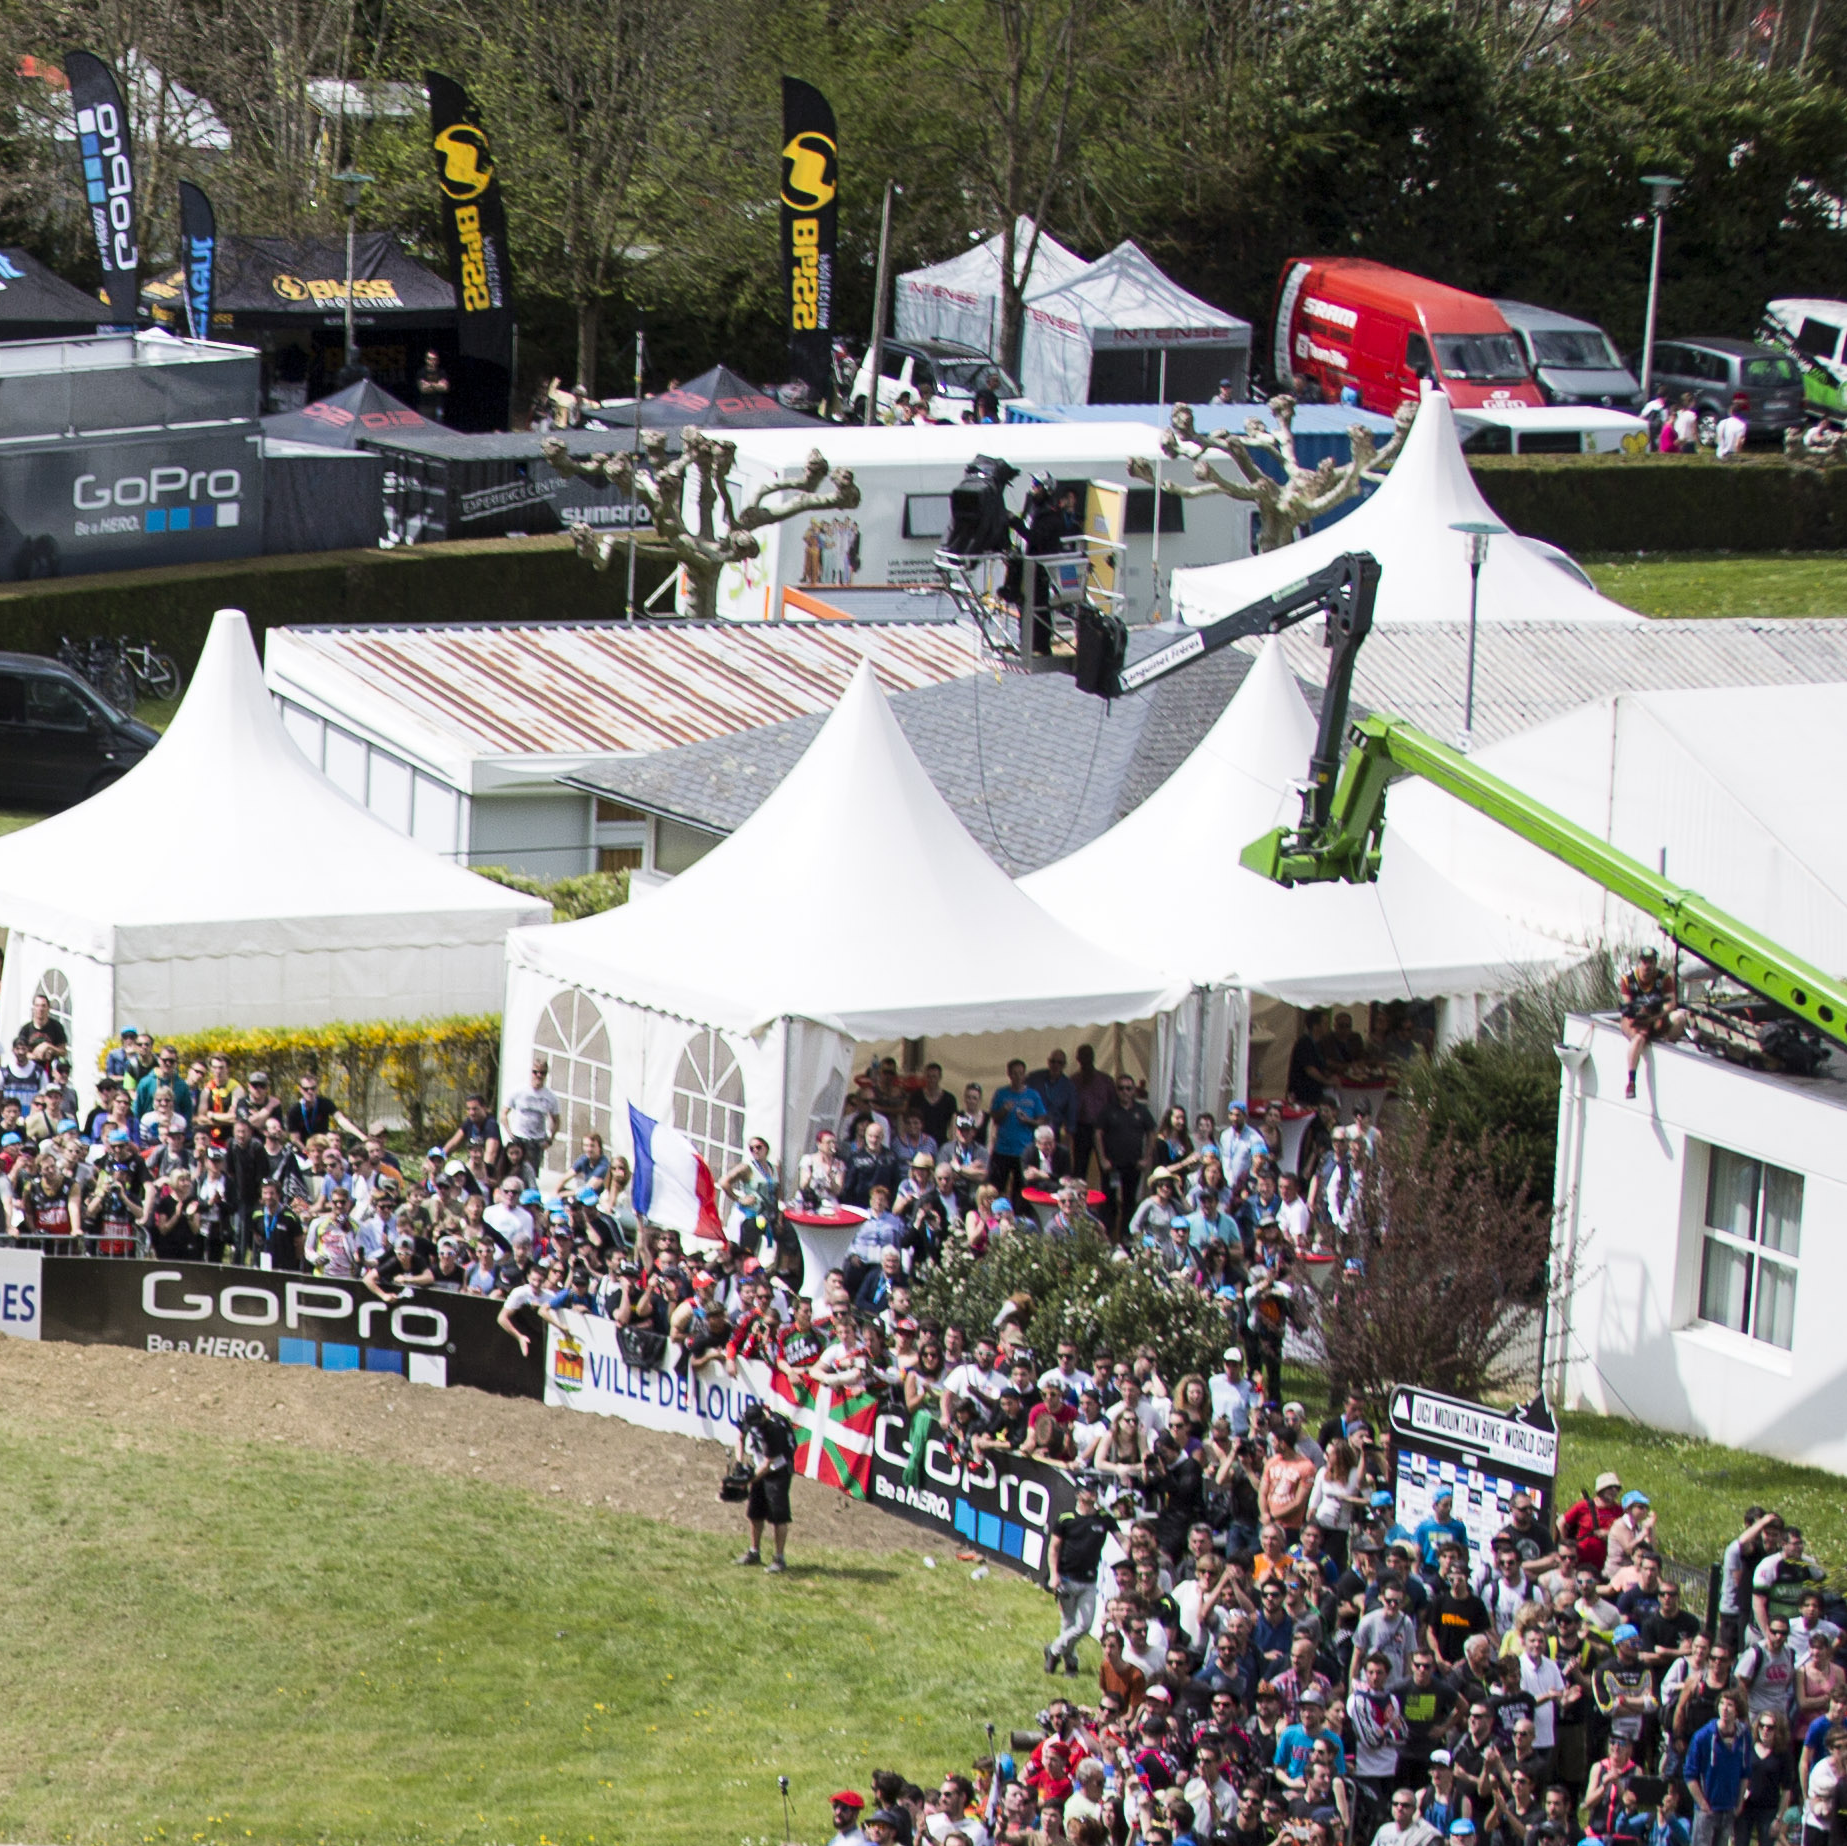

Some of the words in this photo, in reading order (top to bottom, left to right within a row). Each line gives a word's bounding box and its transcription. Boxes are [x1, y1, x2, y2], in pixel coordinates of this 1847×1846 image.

[1113, 327, 1229, 340] INTENSE
[73, 466, 241, 510] GoPro
[560, 504, 651, 524] SHIMANO
[142, 1271, 449, 1347] GoPro
[147, 1334, 174, 1353] Be
[177, 1340, 190, 1353] a
[195, 1336, 270, 1361] HERO.
[876, 1474, 895, 1500] Be
[906, 1483, 952, 1522] HERO.
